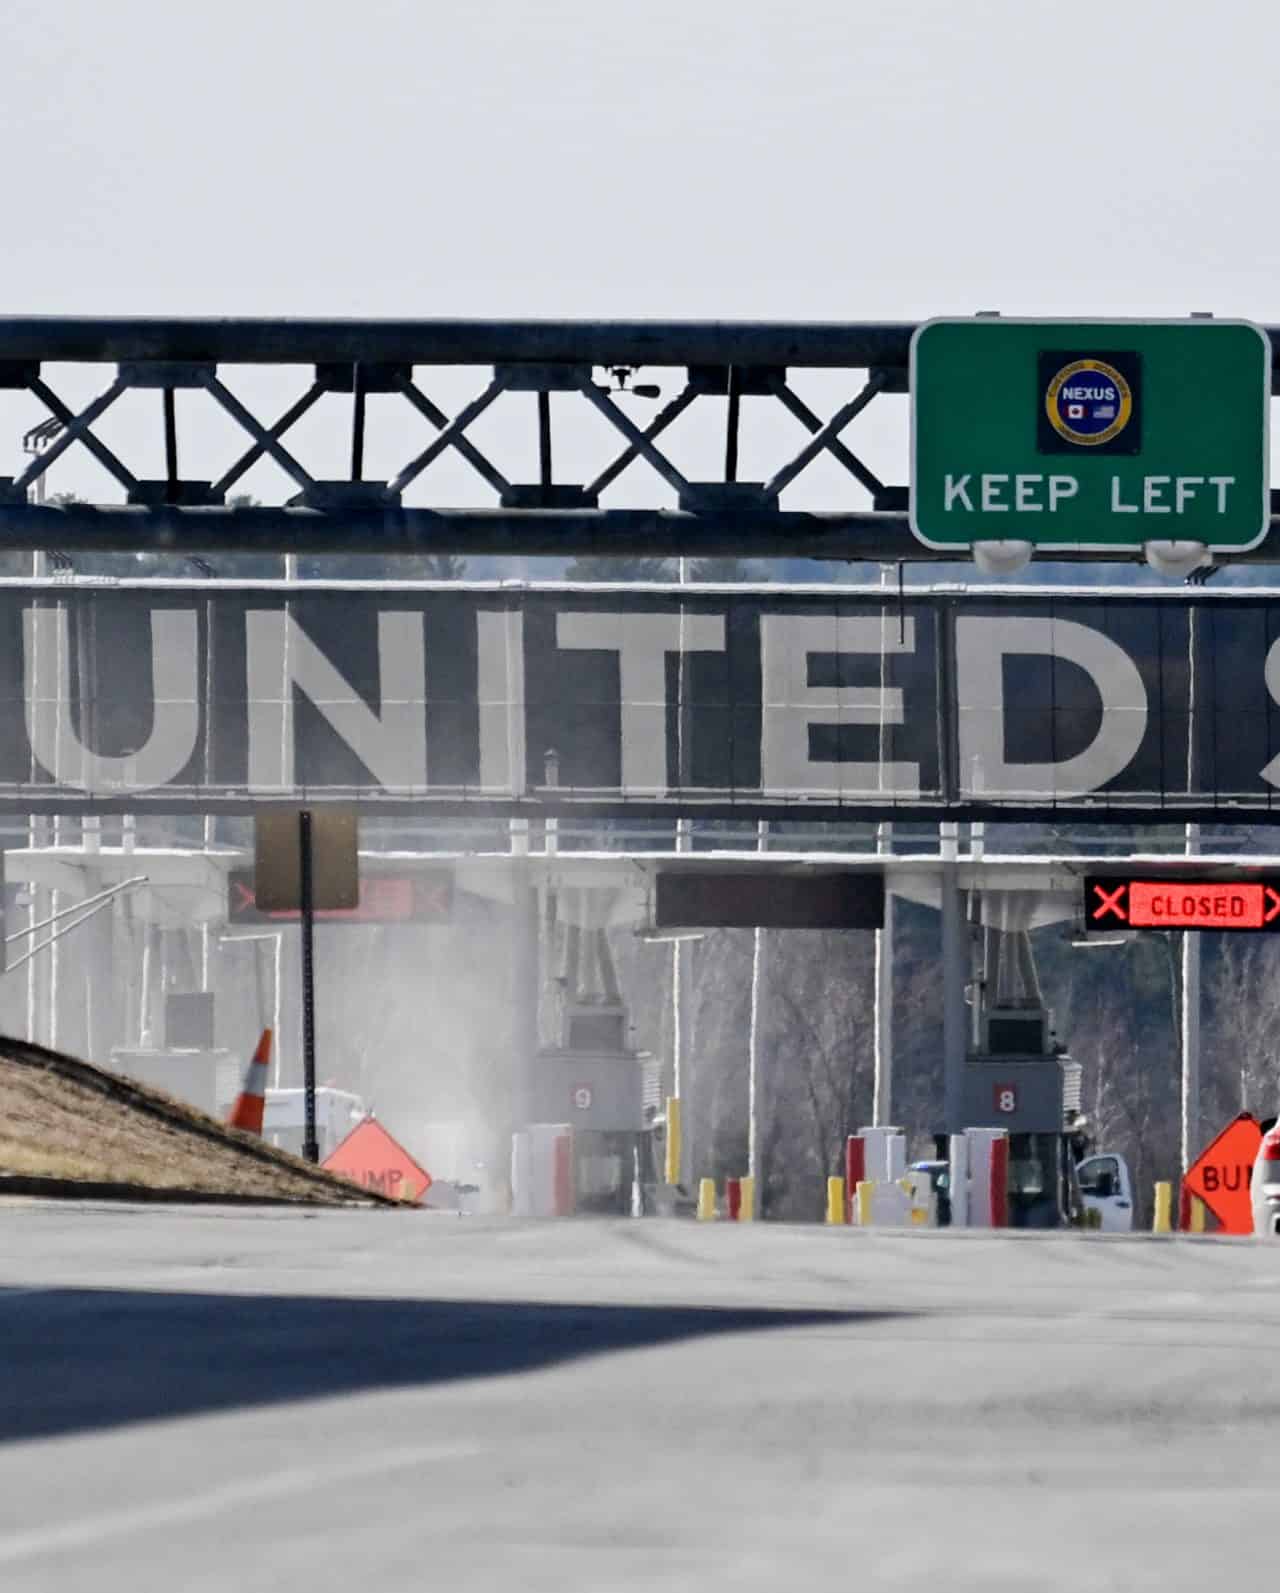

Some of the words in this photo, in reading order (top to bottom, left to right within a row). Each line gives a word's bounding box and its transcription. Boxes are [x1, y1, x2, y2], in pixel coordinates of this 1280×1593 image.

[1063, 387, 1115, 401] NEXUS
[944, 473, 1079, 512] KEEP
[1111, 475, 1236, 514] LEFT
[22, 607, 1148, 799] UNITED
[1151, 896, 1245, 918] CLOSED
[1000, 1090, 1015, 1112] 8
[336, 1168, 404, 1197] UMP
[1203, 1165, 1253, 1192] BU
